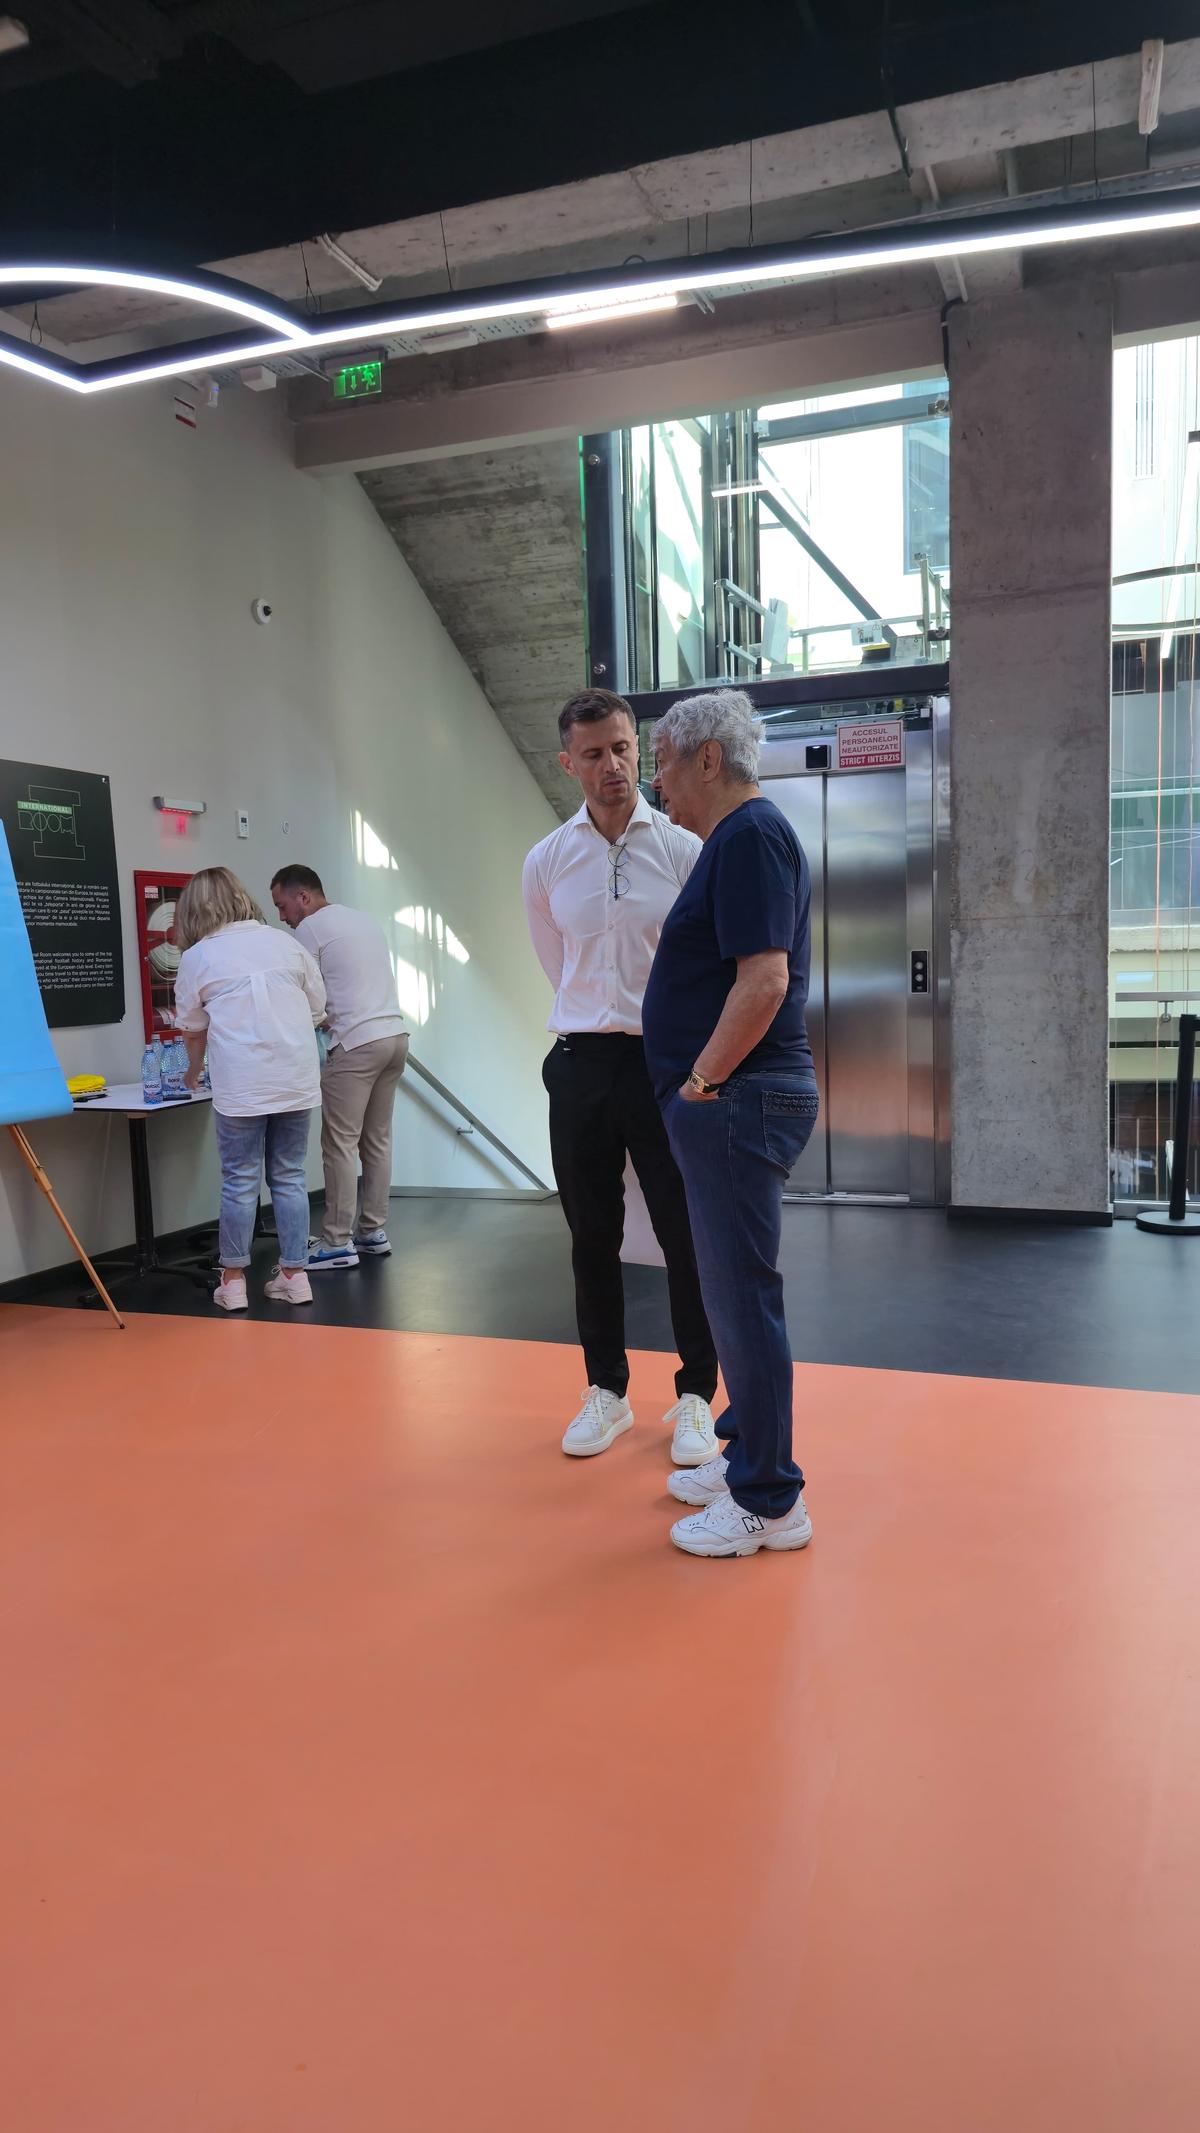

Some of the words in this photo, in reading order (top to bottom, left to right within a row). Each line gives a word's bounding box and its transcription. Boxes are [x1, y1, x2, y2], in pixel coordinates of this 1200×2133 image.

[842, 735, 899, 746] PERSOANELOR
[842, 744, 899, 754] NEAUTORIZATE
[840, 755, 866, 766] STRICT
[867, 753, 900, 764] INTERZIS
[21, 802, 70, 814] INTERNATIONAL
